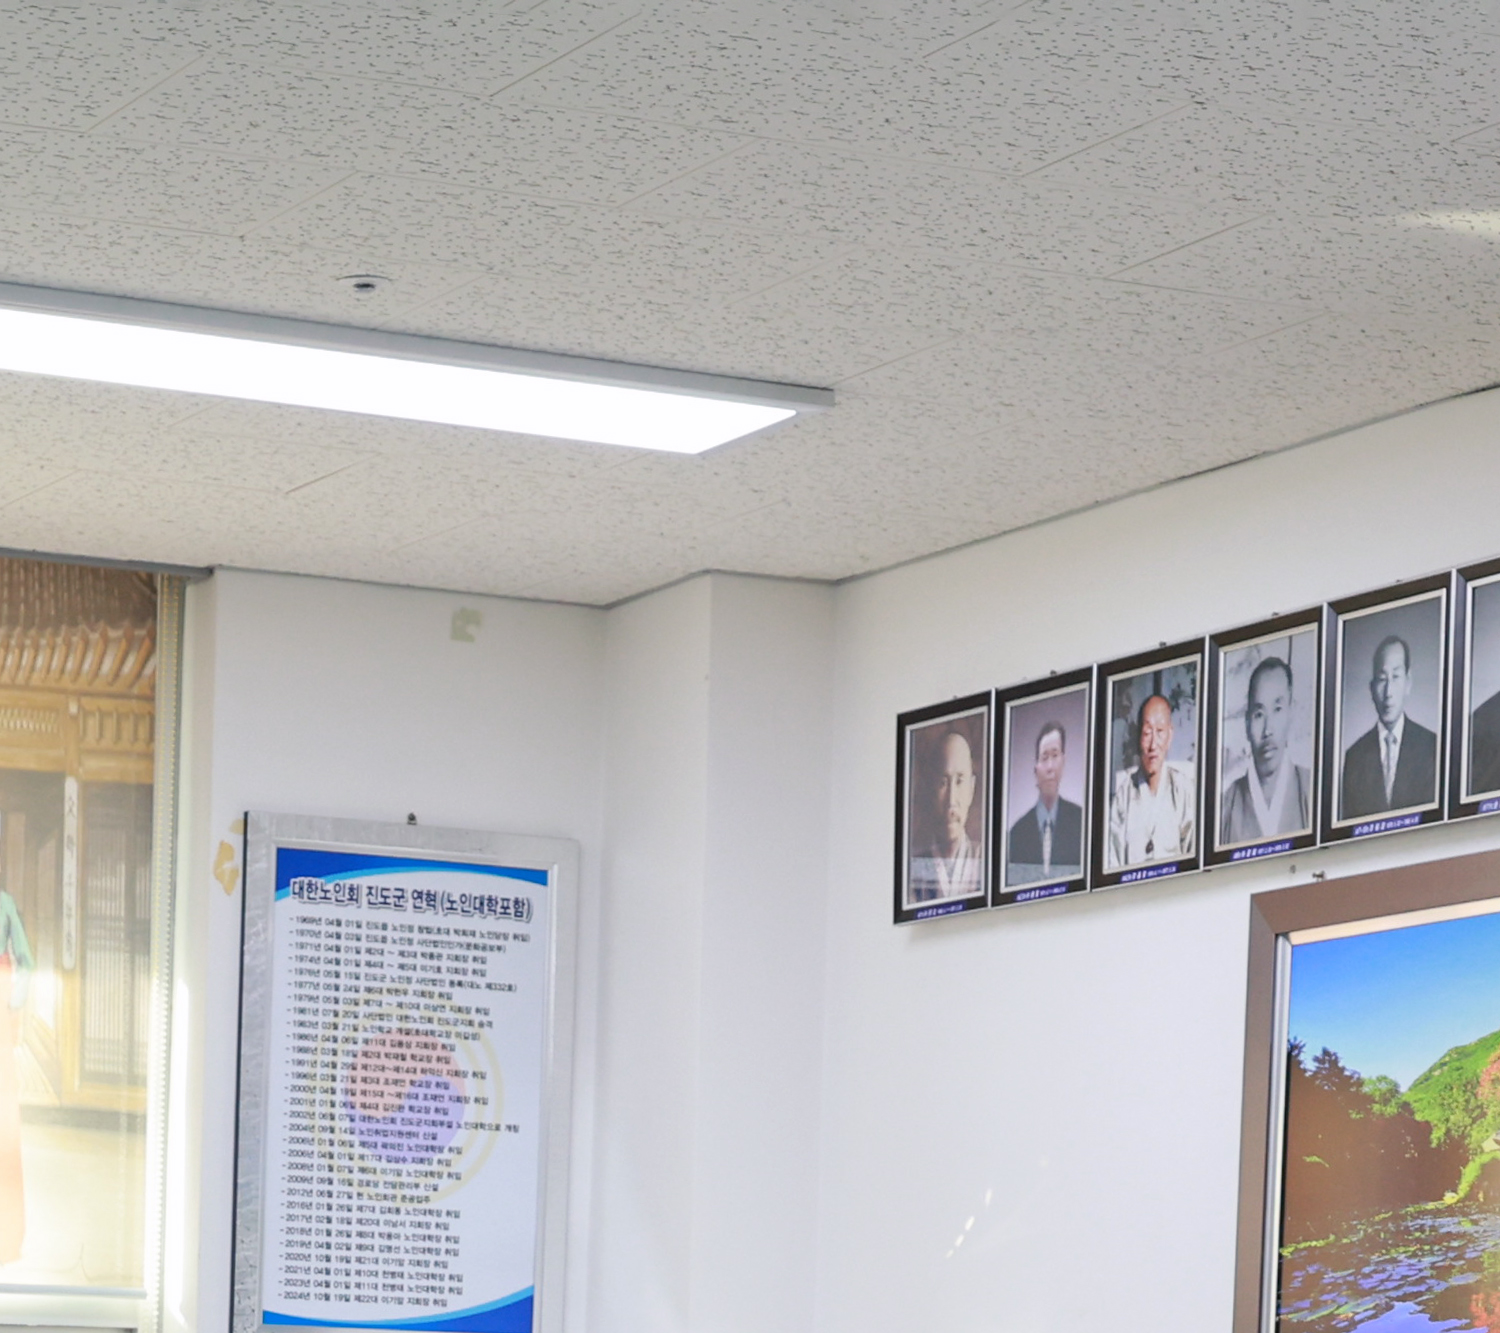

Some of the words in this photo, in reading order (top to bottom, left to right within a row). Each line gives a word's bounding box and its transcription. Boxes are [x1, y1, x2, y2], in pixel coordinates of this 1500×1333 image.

[291, 877, 359, 904] 대한노인회
[365, 883, 406, 908] 진도군
[410, 887, 438, 910] 연혁
